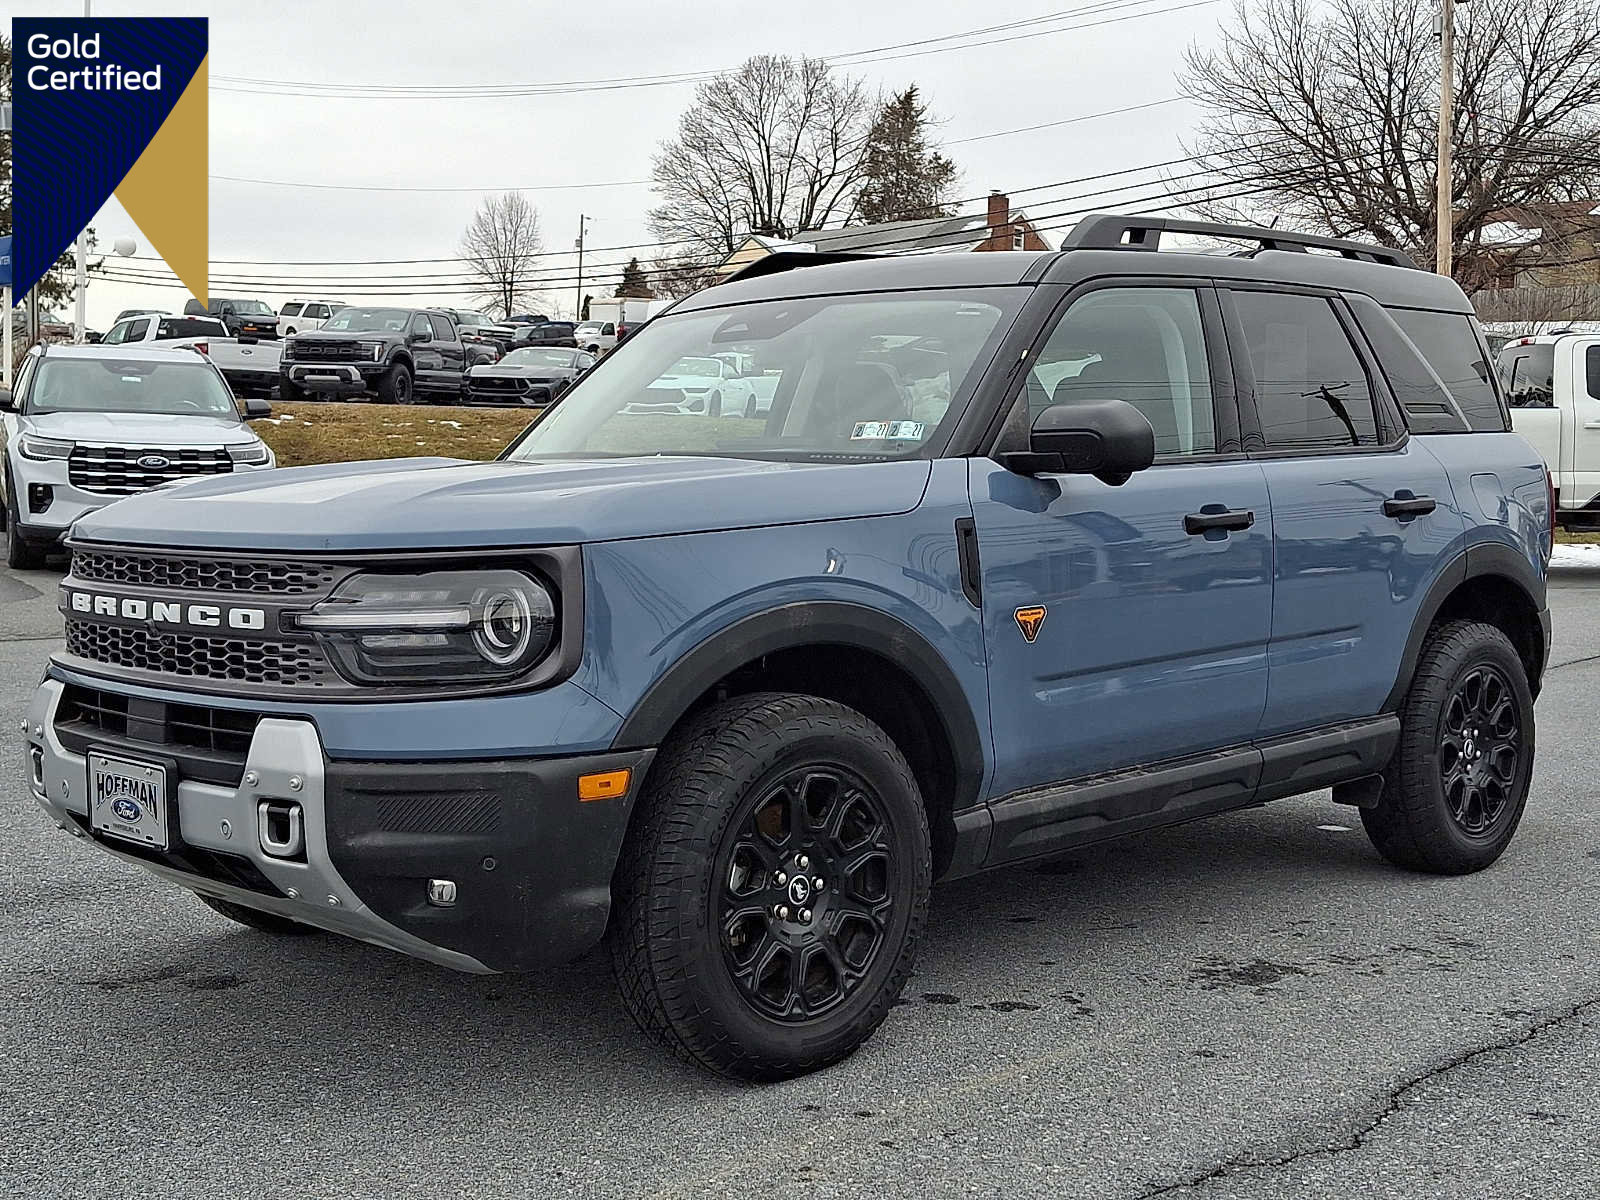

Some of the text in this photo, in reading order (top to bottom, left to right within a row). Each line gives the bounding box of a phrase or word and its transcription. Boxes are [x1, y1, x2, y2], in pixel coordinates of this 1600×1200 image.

[911, 423, 923, 437] 27
[72, 592, 265, 630] BRONCO
[96, 771, 159, 822] HOFFMAN
